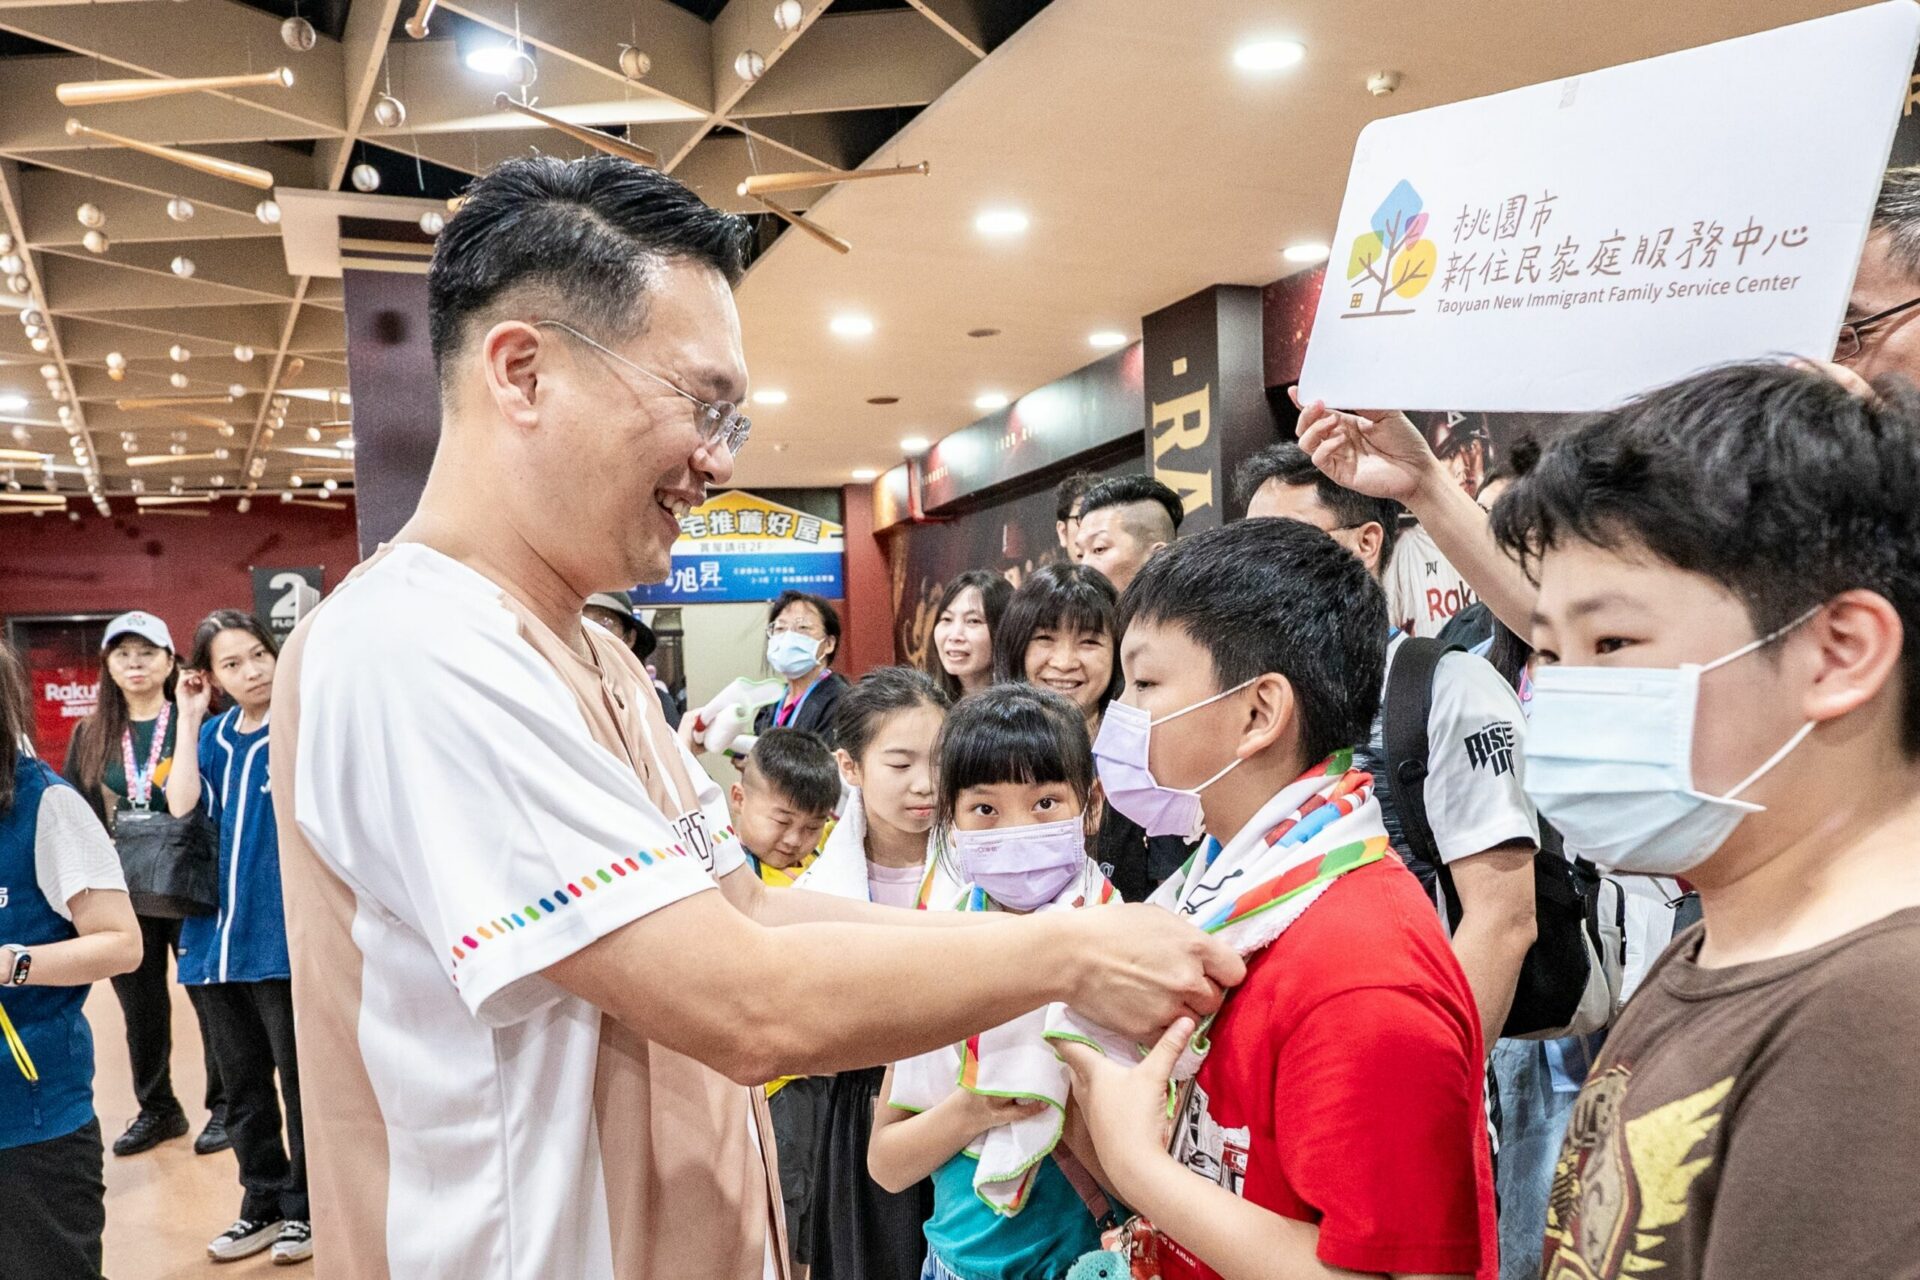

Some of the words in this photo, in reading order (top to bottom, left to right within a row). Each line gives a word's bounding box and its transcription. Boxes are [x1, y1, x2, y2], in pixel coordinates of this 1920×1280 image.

[1453, 189, 1558, 243] 桃園市
[1442, 216, 1808, 292] 新住民家庭服務中心
[1437, 299, 1490, 316] Taoyuan
[1493, 295, 1524, 309] New
[1527, 289, 1605, 310] Immigrant
[1608, 282, 1662, 304] Family
[1666, 278, 1731, 299] Service
[1736, 275, 1801, 293] Center
[270, 572, 308, 618] 2
[667, 561, 722, 593] 旭昇
[1426, 581, 1479, 621] Rak
[271, 618, 296, 628] FLO
[1464, 727, 1515, 771] RISE
